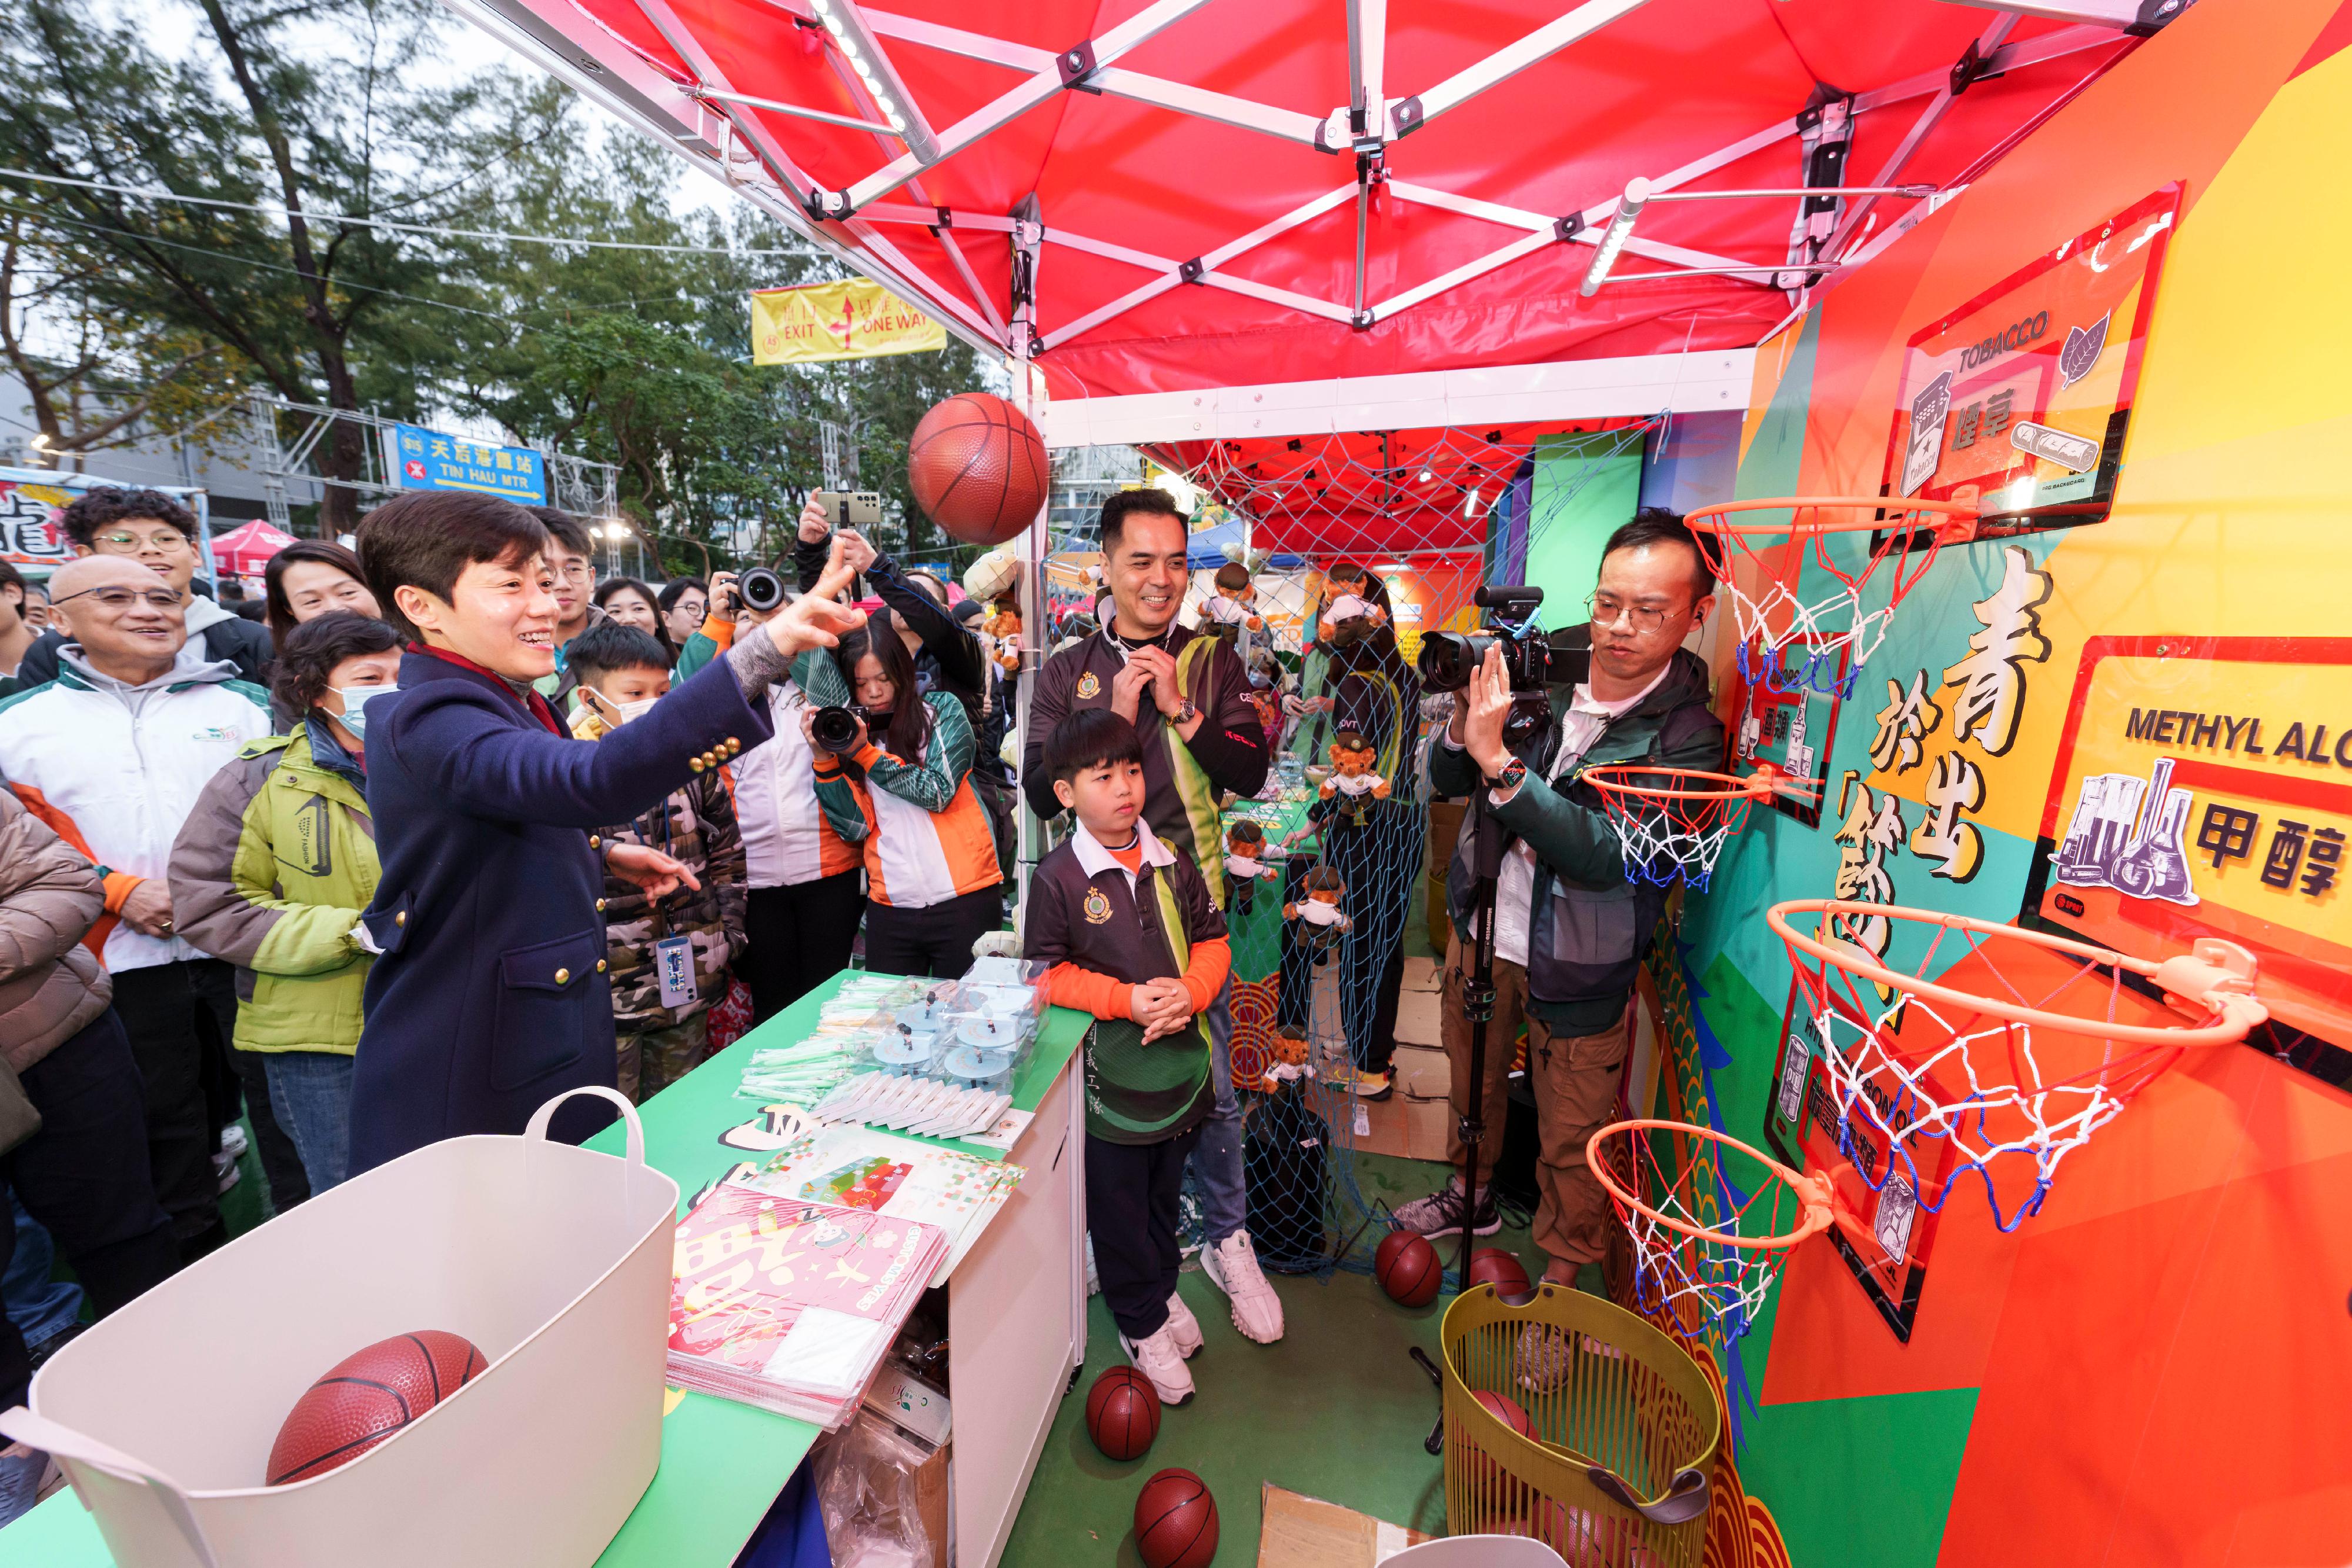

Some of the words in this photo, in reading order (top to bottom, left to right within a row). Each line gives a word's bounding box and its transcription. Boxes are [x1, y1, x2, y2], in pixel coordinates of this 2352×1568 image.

[785, 324, 814, 339] EXIT
[863, 316, 893, 333] ONE
[896, 312, 927, 329] WAY
[1959, 310, 2049, 373] TOBACCO
[1951, 387, 2015, 452] 煙草
[439, 463, 464, 480] TIN
[469, 468, 496, 484] HAU
[502, 474, 529, 489] MTR
[1762, 707, 1788, 741] 酒類
[2125, 707, 2264, 754] METHYL
[302, 838, 310, 864] FASHION
[2197, 803, 2346, 897] 甲醇
[2065, 900, 2083, 914] SPORT
[1787, 1068, 1800, 1091] OIL
